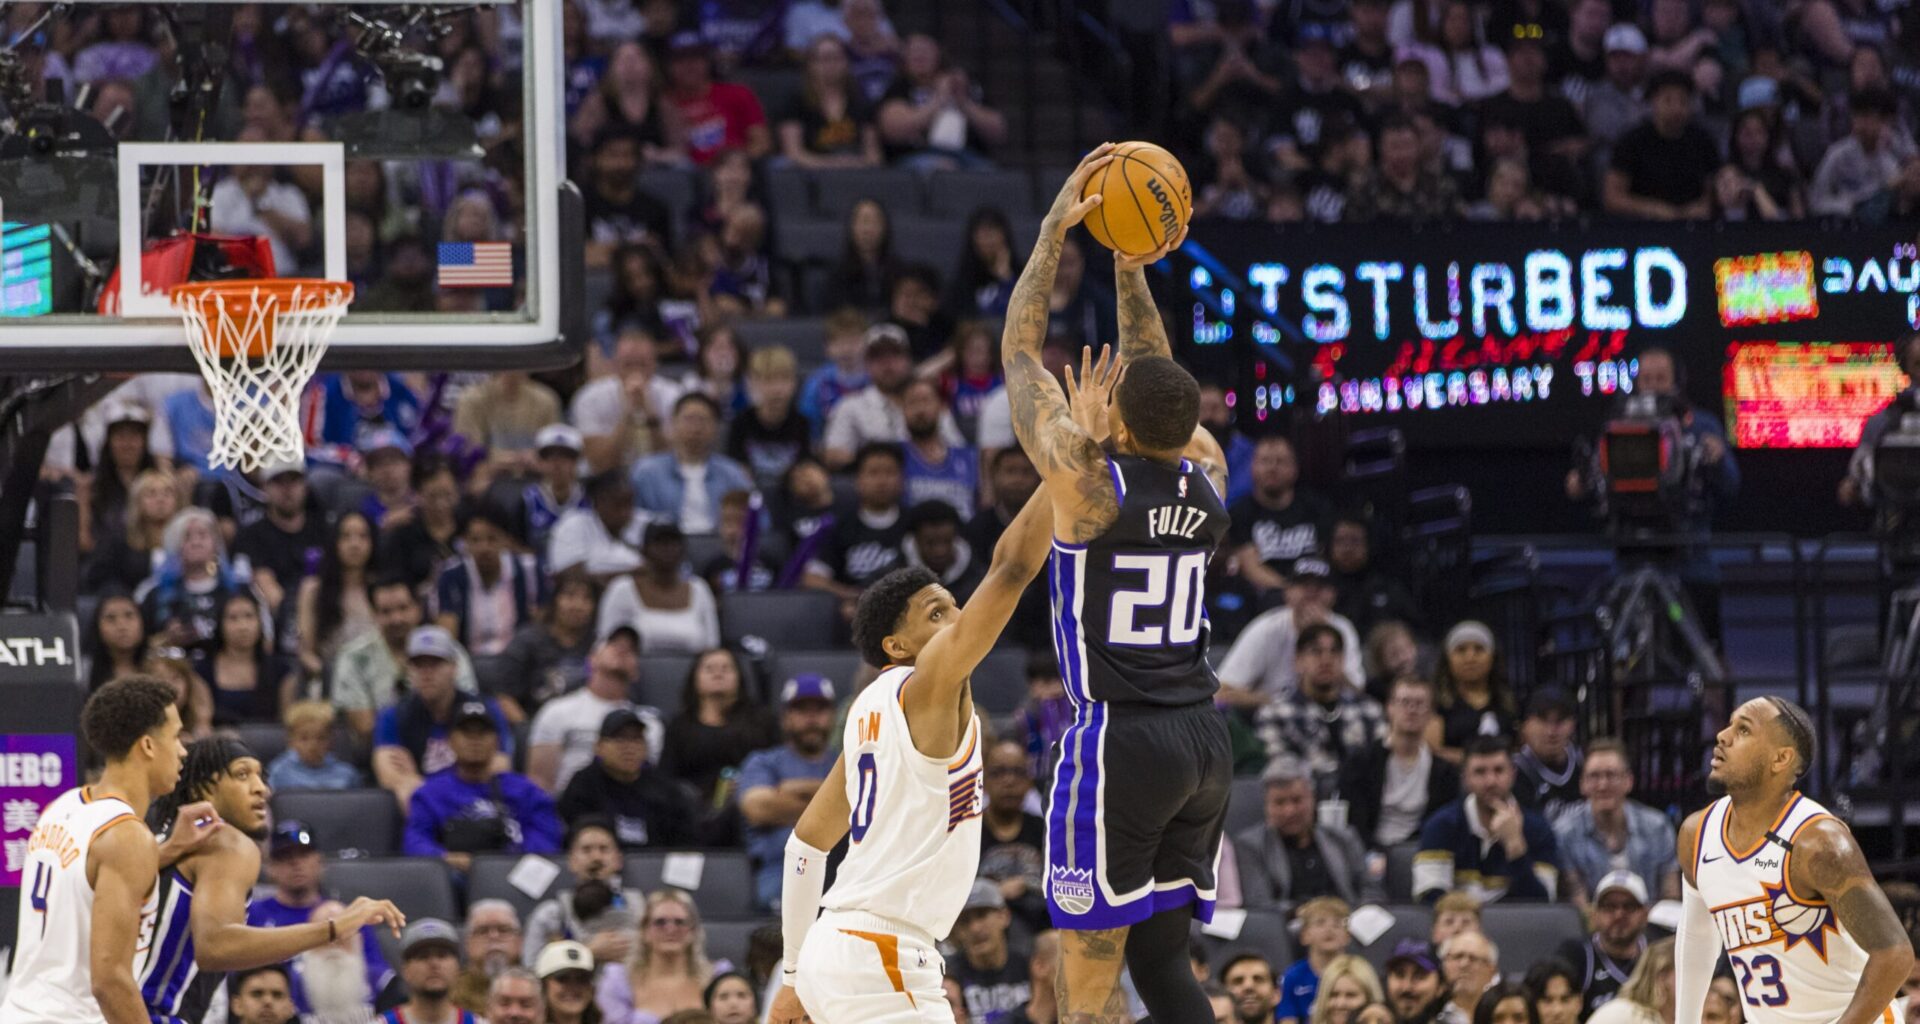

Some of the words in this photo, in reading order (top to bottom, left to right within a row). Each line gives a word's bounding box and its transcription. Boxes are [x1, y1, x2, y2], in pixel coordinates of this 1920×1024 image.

[1148, 505, 1208, 539] FULTZ
[1107, 551, 1206, 647] 20
[0, 752, 62, 787] EBO
[851, 752, 878, 845] 0
[1754, 858, 1779, 870] PayPal
[1054, 884, 1093, 898] KINGS
[1731, 953, 1790, 1007] 23
